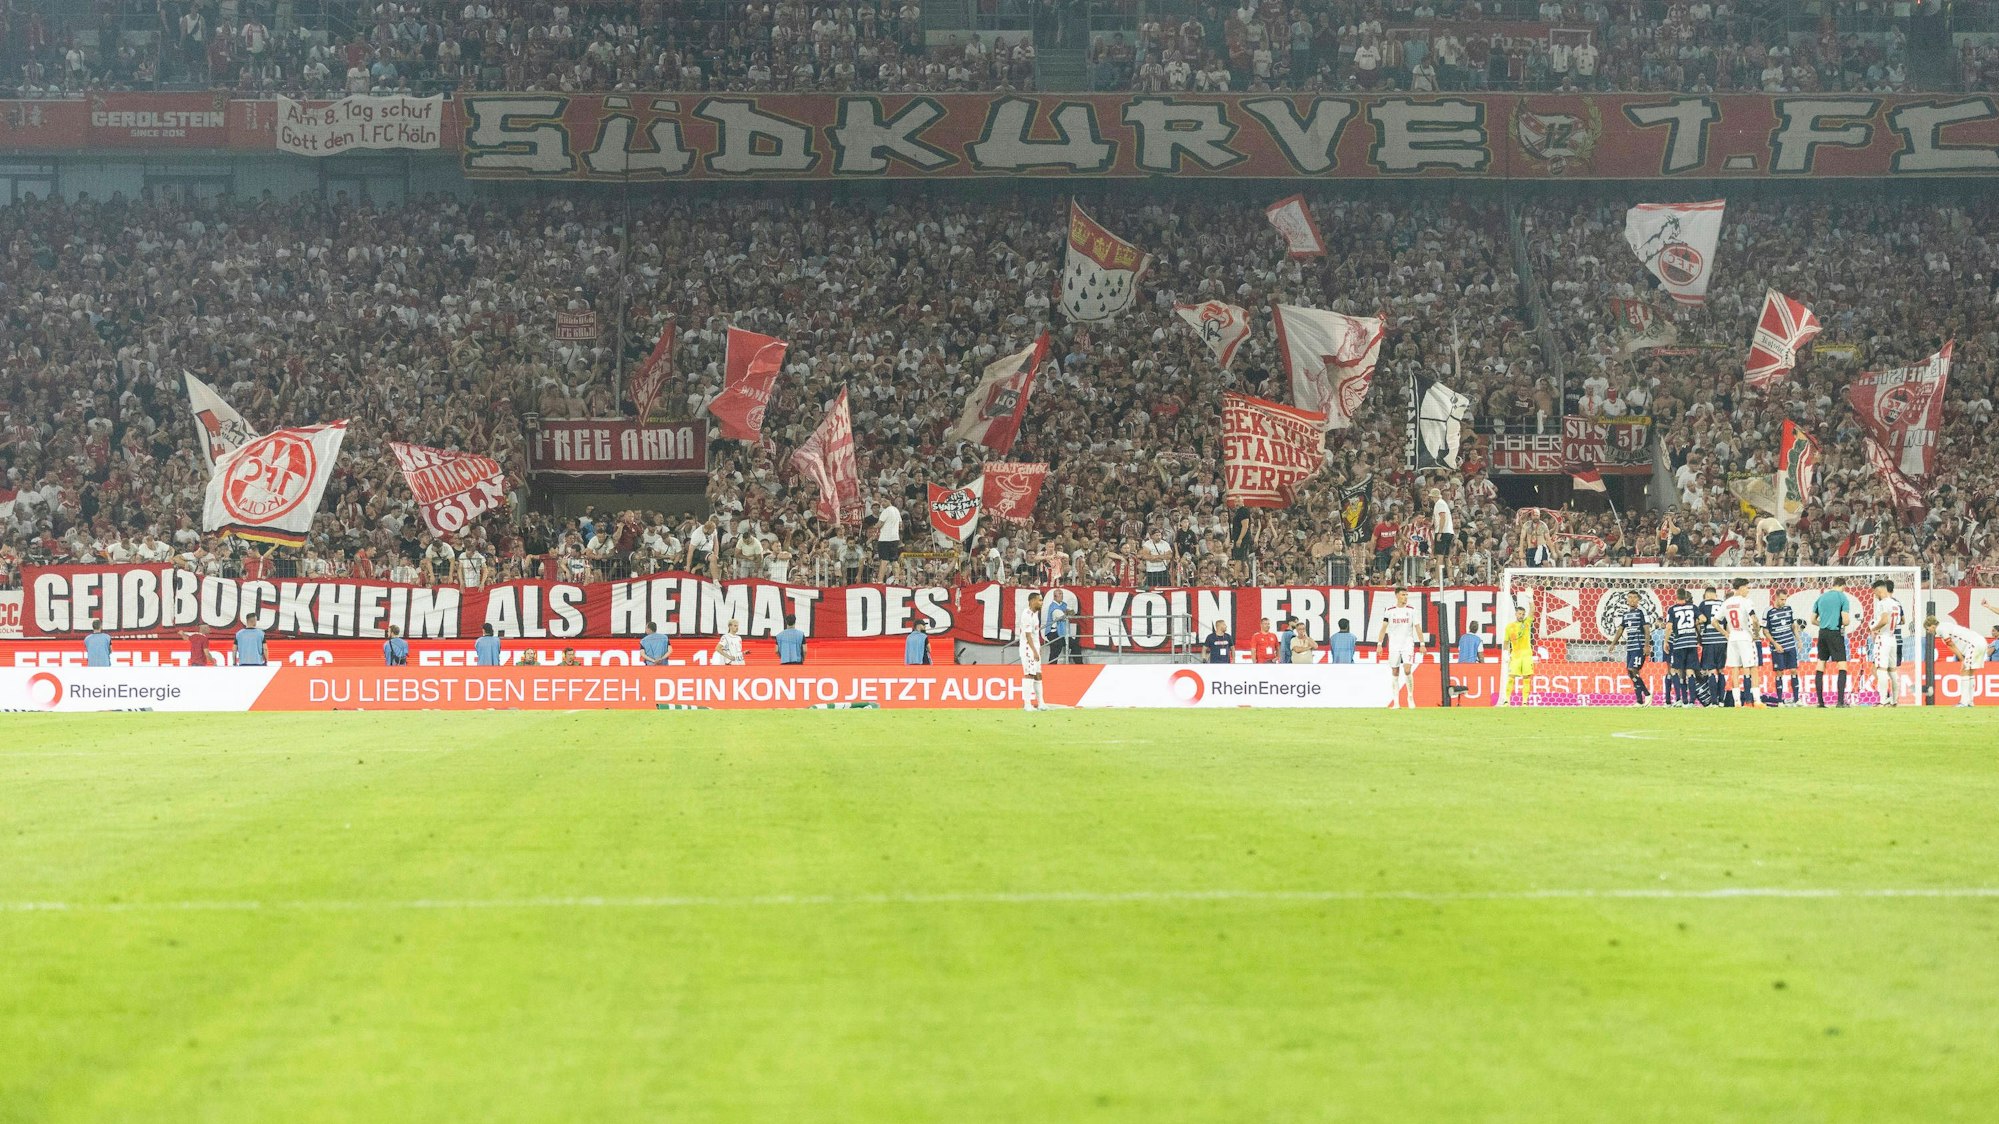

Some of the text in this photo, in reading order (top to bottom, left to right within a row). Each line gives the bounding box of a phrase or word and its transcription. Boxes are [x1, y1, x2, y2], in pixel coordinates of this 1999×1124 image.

[92, 111, 225, 127] GEROLSTEIN
[287, 98, 432, 126] Am 8. Tag schuf
[131, 129, 186, 137] SINCE 2012
[281, 126, 318, 150] Gott
[324, 131, 354, 149] den
[399, 122, 436, 143] Köln
[465, 97, 1487, 174] SÜDKURVE
[1546, 123, 1573, 149] 12
[1566, 443, 1607, 462] CGN
[486, 578, 587, 638] ALS
[610, 577, 820, 637] HEIMAT
[846, 586, 953, 638] DES
[1093, 588, 1232, 648] KÖLN
[1674, 610, 1695, 630] 23
[1729, 609, 1740, 629] 8
[69, 683, 181, 701] RheinEnergie
[310, 678, 353, 703] DU
[358, 678, 457, 702] LIEBST
[465, 678, 525, 702] DEN
[533, 678, 645, 702] EFFZEH.
[655, 678, 730, 702] DEIN
[734, 677, 839, 701] KONTO
[844, 677, 937, 701] JETZT
[1211, 680, 1322, 698] RheinEnergie
